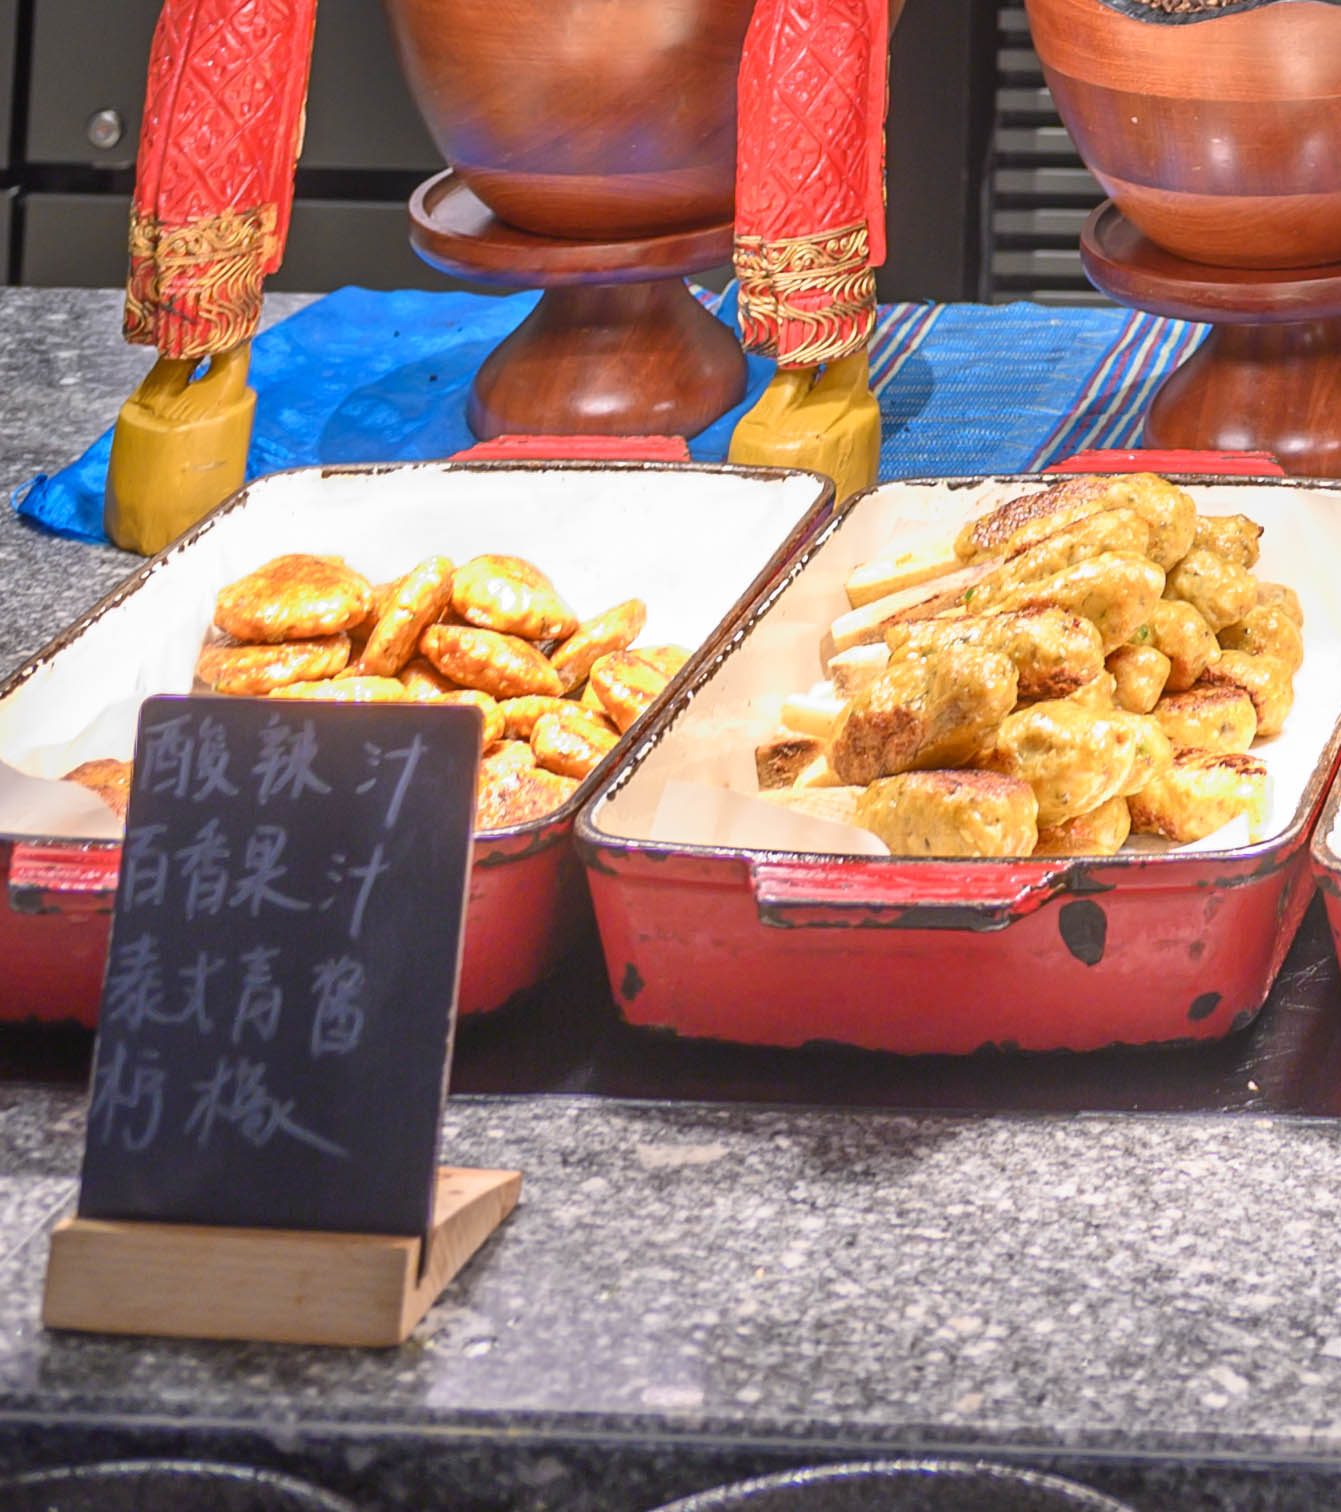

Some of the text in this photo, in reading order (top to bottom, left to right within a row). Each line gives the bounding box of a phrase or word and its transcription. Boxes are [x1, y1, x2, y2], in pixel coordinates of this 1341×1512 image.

[142, 712, 428, 830] 酸辣汁
[125, 818, 390, 940] 百香果汁
